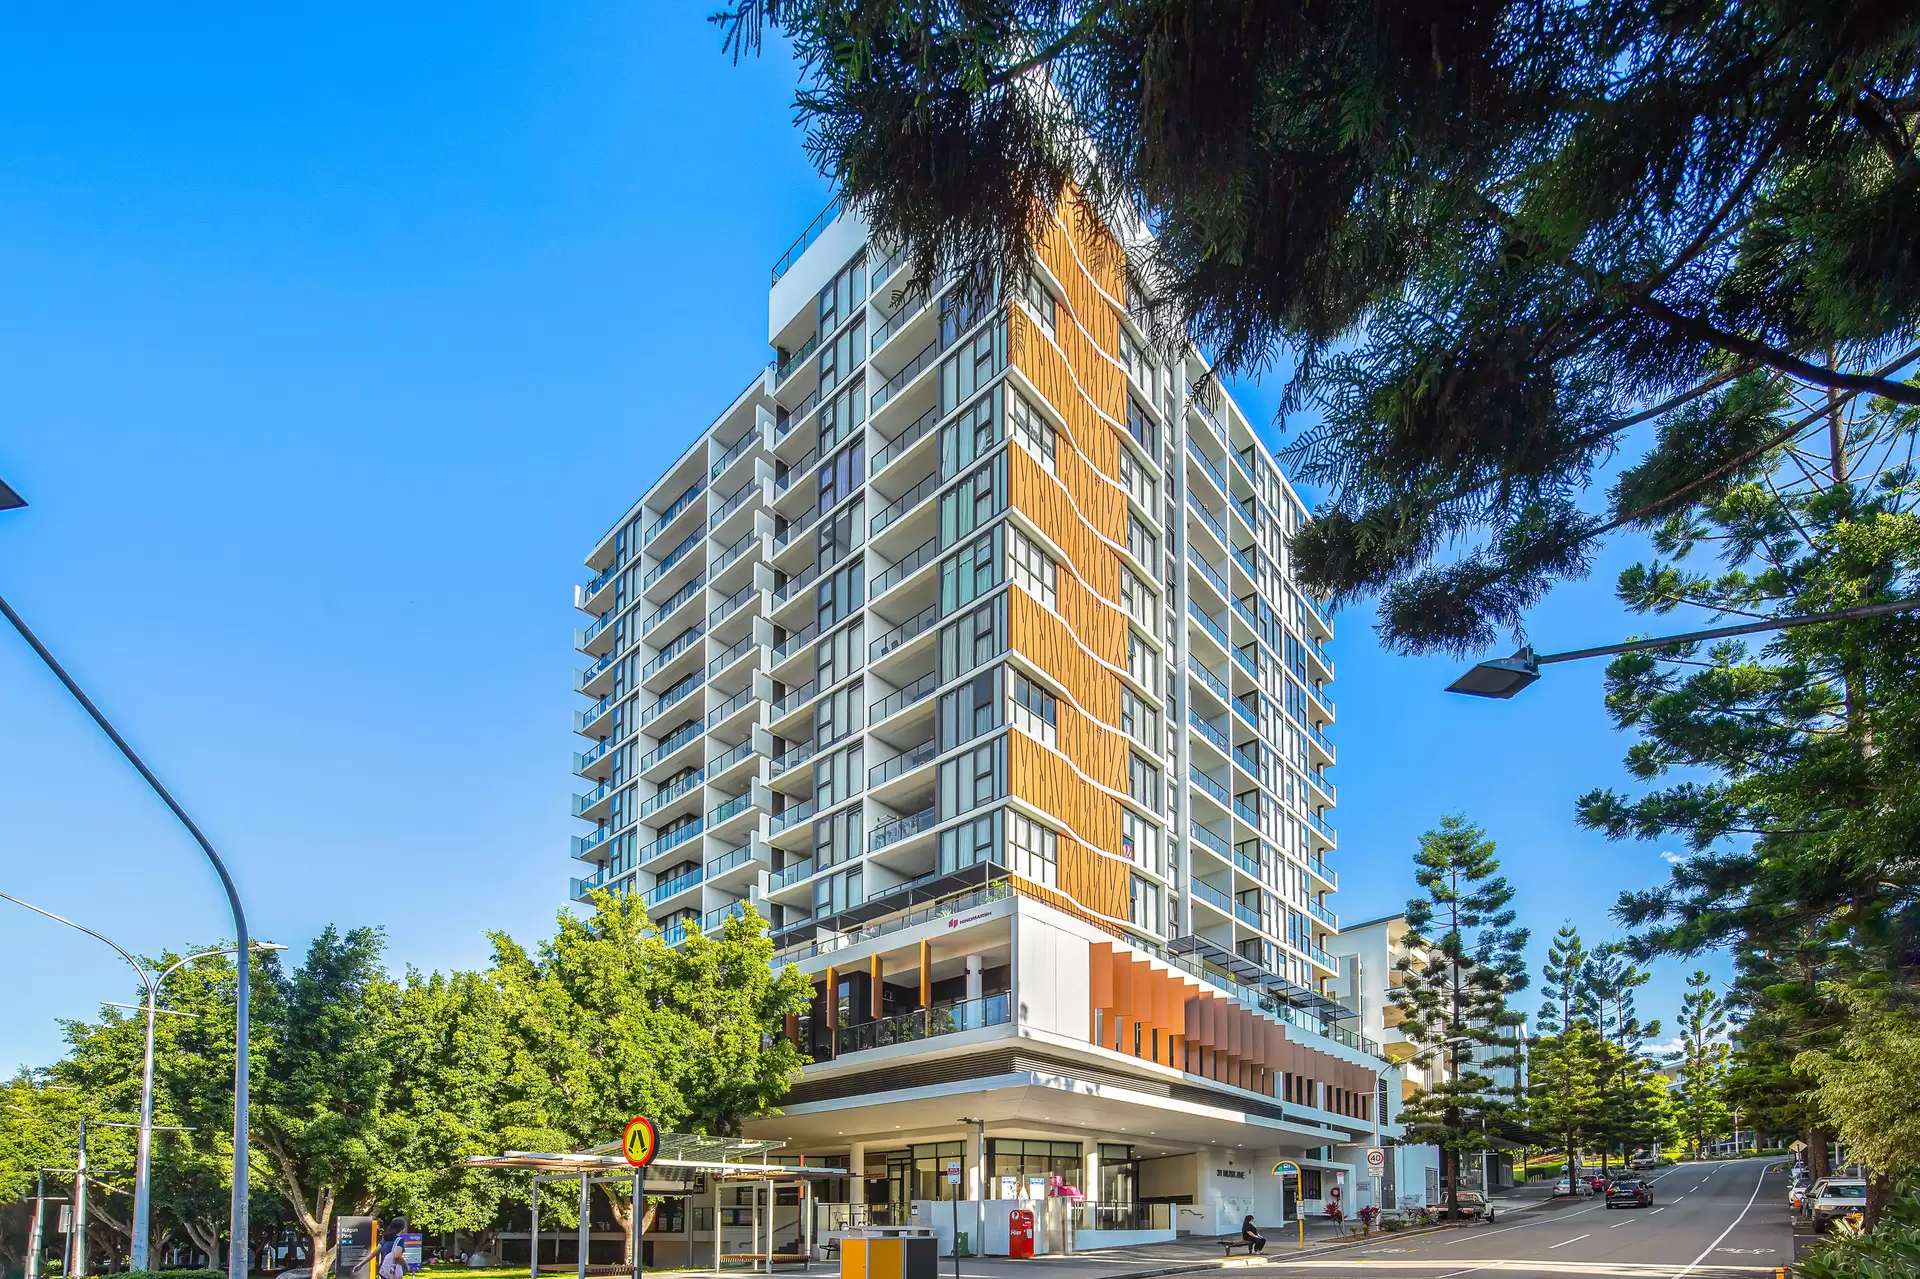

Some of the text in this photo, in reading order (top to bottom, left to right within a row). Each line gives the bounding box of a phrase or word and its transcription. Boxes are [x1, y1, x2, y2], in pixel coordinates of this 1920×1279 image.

[959, 911, 992, 924] HINDMARSH
[1370, 1154, 1381, 1162] 40
[1216, 1169, 1222, 1177] 31
